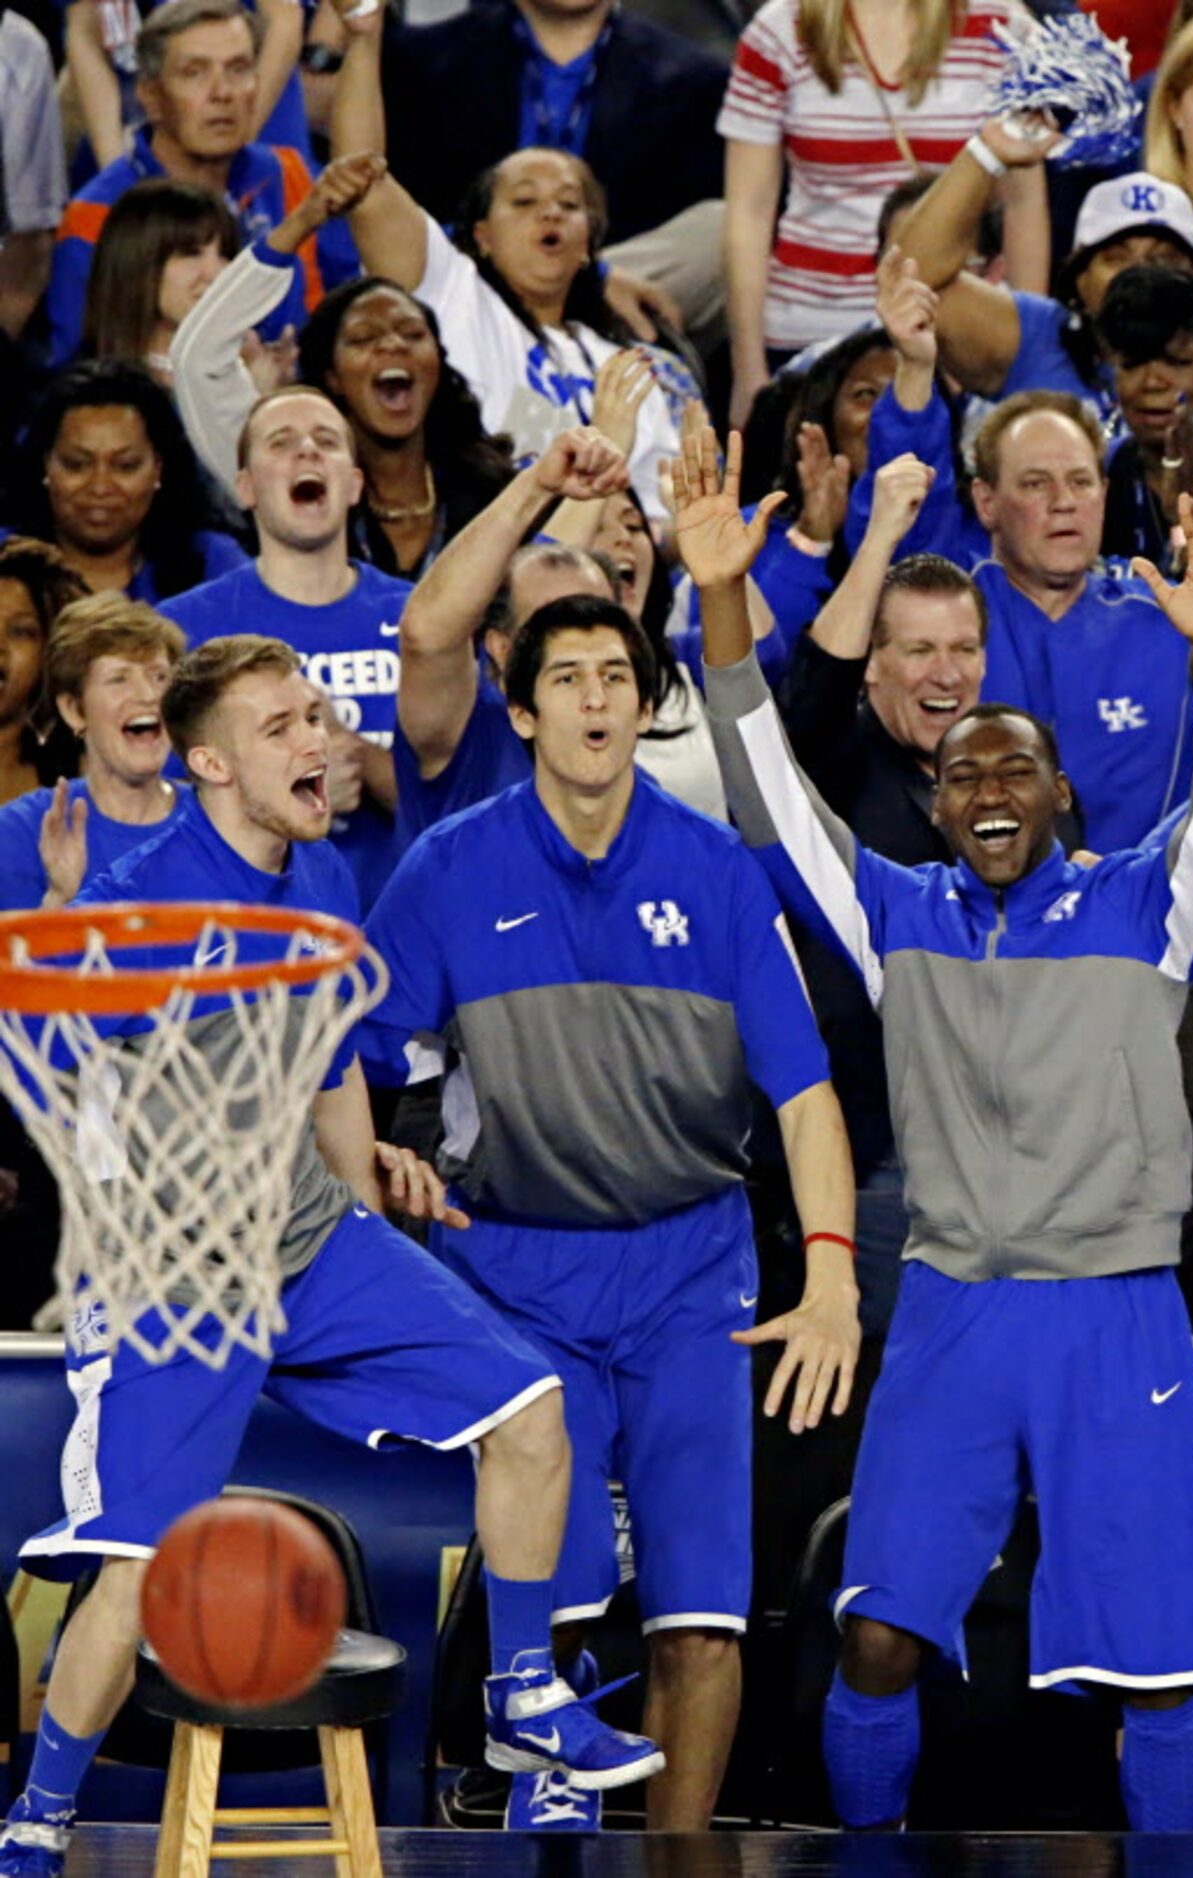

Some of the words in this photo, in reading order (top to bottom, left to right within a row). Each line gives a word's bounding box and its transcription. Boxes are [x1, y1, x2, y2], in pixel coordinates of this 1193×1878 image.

[1131, 185, 1158, 213] K
[299, 649, 401, 697] CEED
[636, 899, 690, 948] UK
